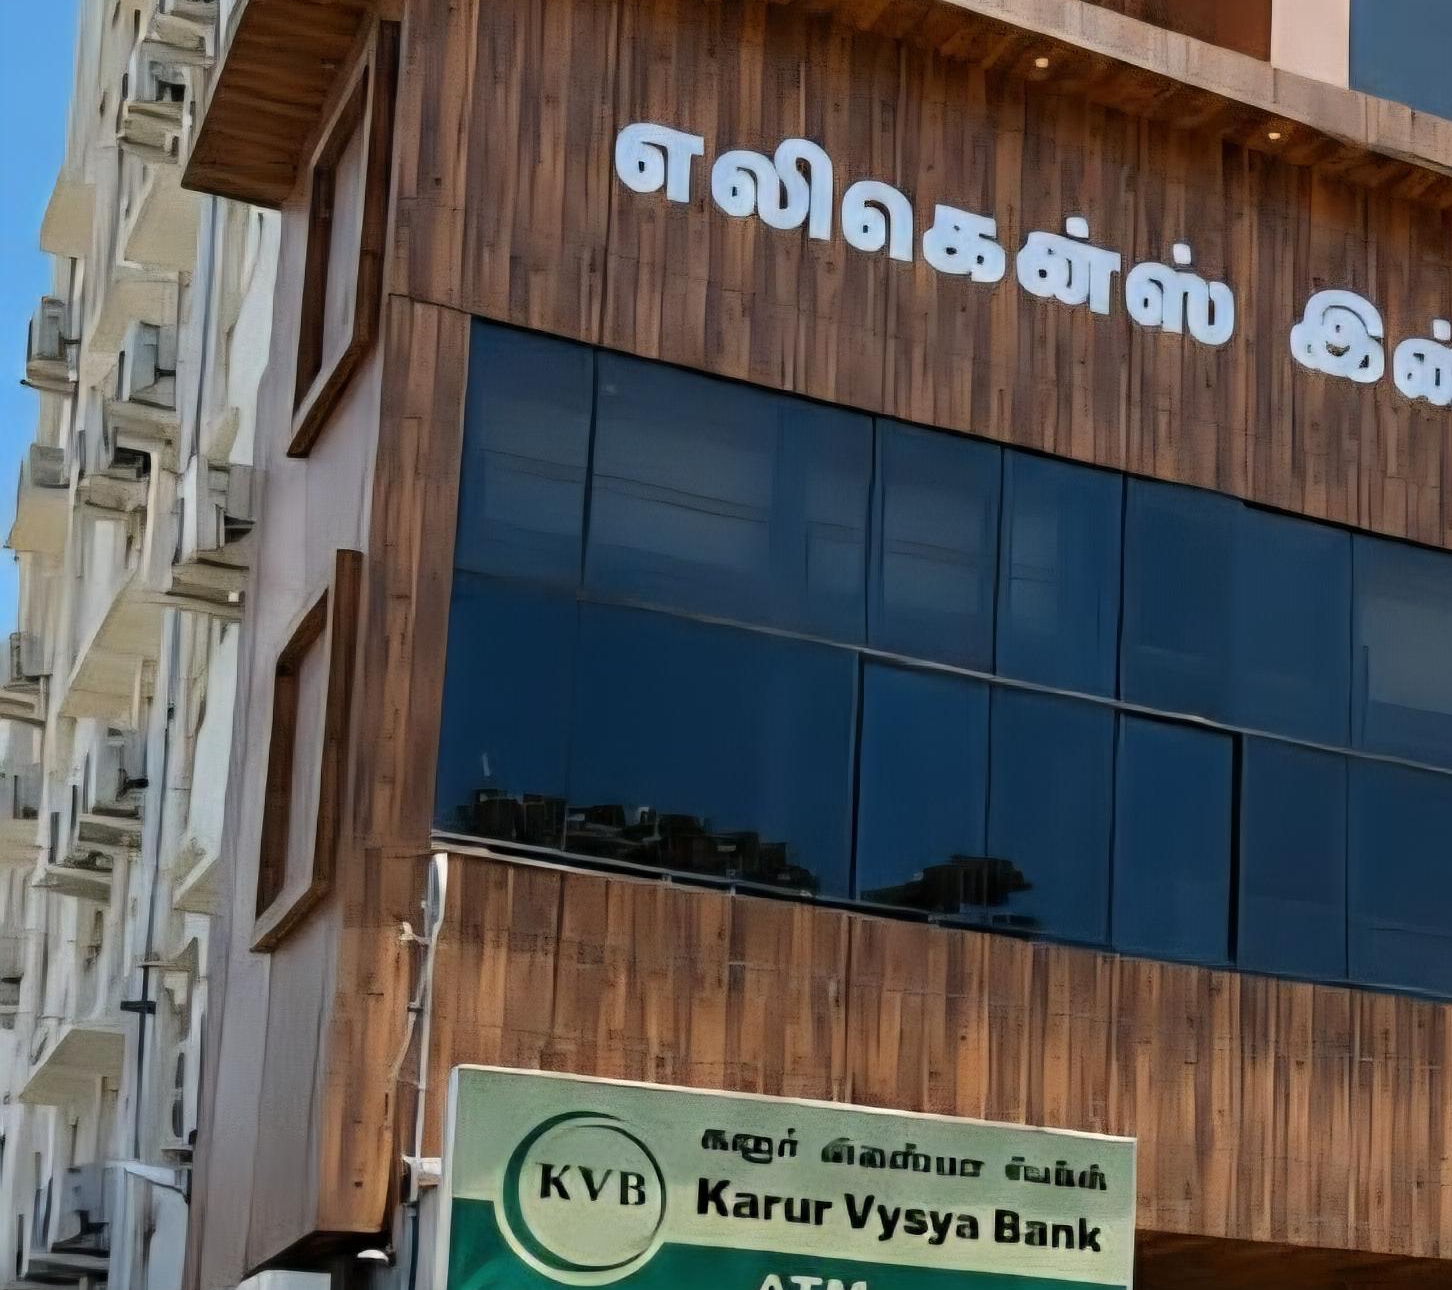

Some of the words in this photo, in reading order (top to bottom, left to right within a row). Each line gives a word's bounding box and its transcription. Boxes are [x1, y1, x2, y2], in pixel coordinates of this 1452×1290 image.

[537, 1161, 647, 1206] KVB
[697, 1178, 833, 1226] Karur
[844, 1194, 980, 1246] Vysya
[994, 1209, 1101, 1252] Bank
